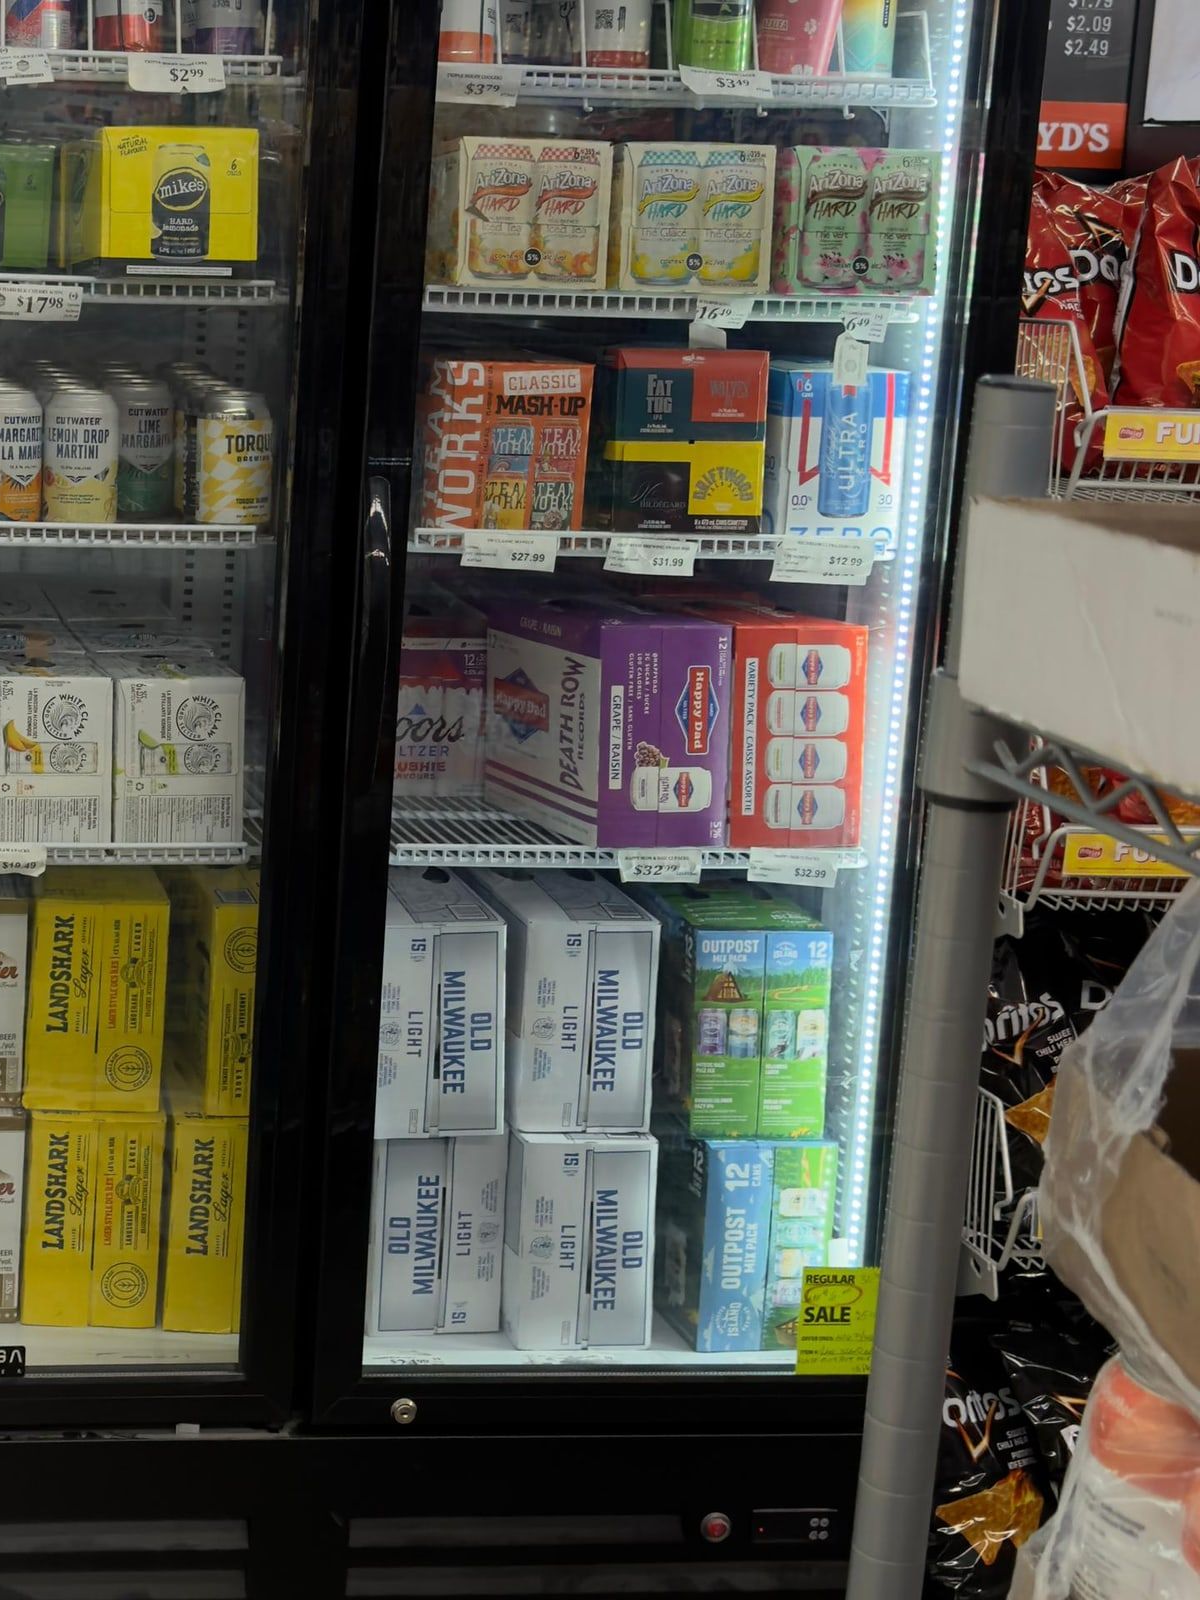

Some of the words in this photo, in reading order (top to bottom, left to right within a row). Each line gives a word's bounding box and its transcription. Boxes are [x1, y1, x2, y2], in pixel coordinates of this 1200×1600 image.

[1066, 15, 1111, 32] $2.09
[1064, 39, 1108, 56] $2.49
[1038, 123, 1109, 152] YD'S
[159, 178, 206, 199] mike's
[475, 168, 529, 188] AriZona
[540, 171, 593, 191] AriZona
[169, 217, 193, 225] HARD
[508, 375, 577, 391] CLASSIC
[647, 374, 674, 397] FAT
[495, 395, 586, 416] MASH-UP
[56, 416, 100, 425] CUTWATER
[138, 420, 160, 433] LIME
[83, 429, 109, 443] DROP
[435, 361, 485, 529] WORKS
[56, 444, 98, 459] MARTINI
[511, 552, 545, 562] $27.99
[652, 557, 683, 567] $31.99
[561, 657, 586, 707] ROW
[693, 671, 705, 717] Happy
[747, 661, 755, 698] VARIETY
[578, 692, 586, 760] RECORDS
[613, 695, 622, 729] GRAPE
[746, 702, 754, 725] PACK
[694, 721, 704, 750] Dad
[559, 713, 583, 792] DEATH
[611, 740, 621, 780] RAISIN
[745, 736, 753, 765] CAISSE
[744, 769, 752, 812] ASSORTIE
[794, 868, 826, 878] $32.99
[702, 940, 759, 953] OUTPOST
[46, 915, 76, 1033] LANDSHARK
[442, 970, 466, 1094] MILWAUKEE
[470, 1012, 492, 1050] OLD
[592, 970, 620, 1092] MILWAUKEE
[622, 1012, 644, 1050] OLD
[984, 992, 1065, 1045] oritos
[1047, 1028, 1073, 1043] SWEE
[42, 1132, 69, 1251] LANDSHARK
[726, 1163, 749, 1192] 12
[186, 1138, 215, 1256] LANDSHARK
[388, 1217, 411, 1254] OLD
[412, 1175, 440, 1295] MILWAUKEE
[622, 1230, 644, 1269] OLD
[721, 1206, 746, 1289] OUTPOST
[593, 1190, 618, 1311] MILWAUKEE
[806, 1275, 854, 1285] REGULAR
[803, 1306, 850, 1323] SALE
